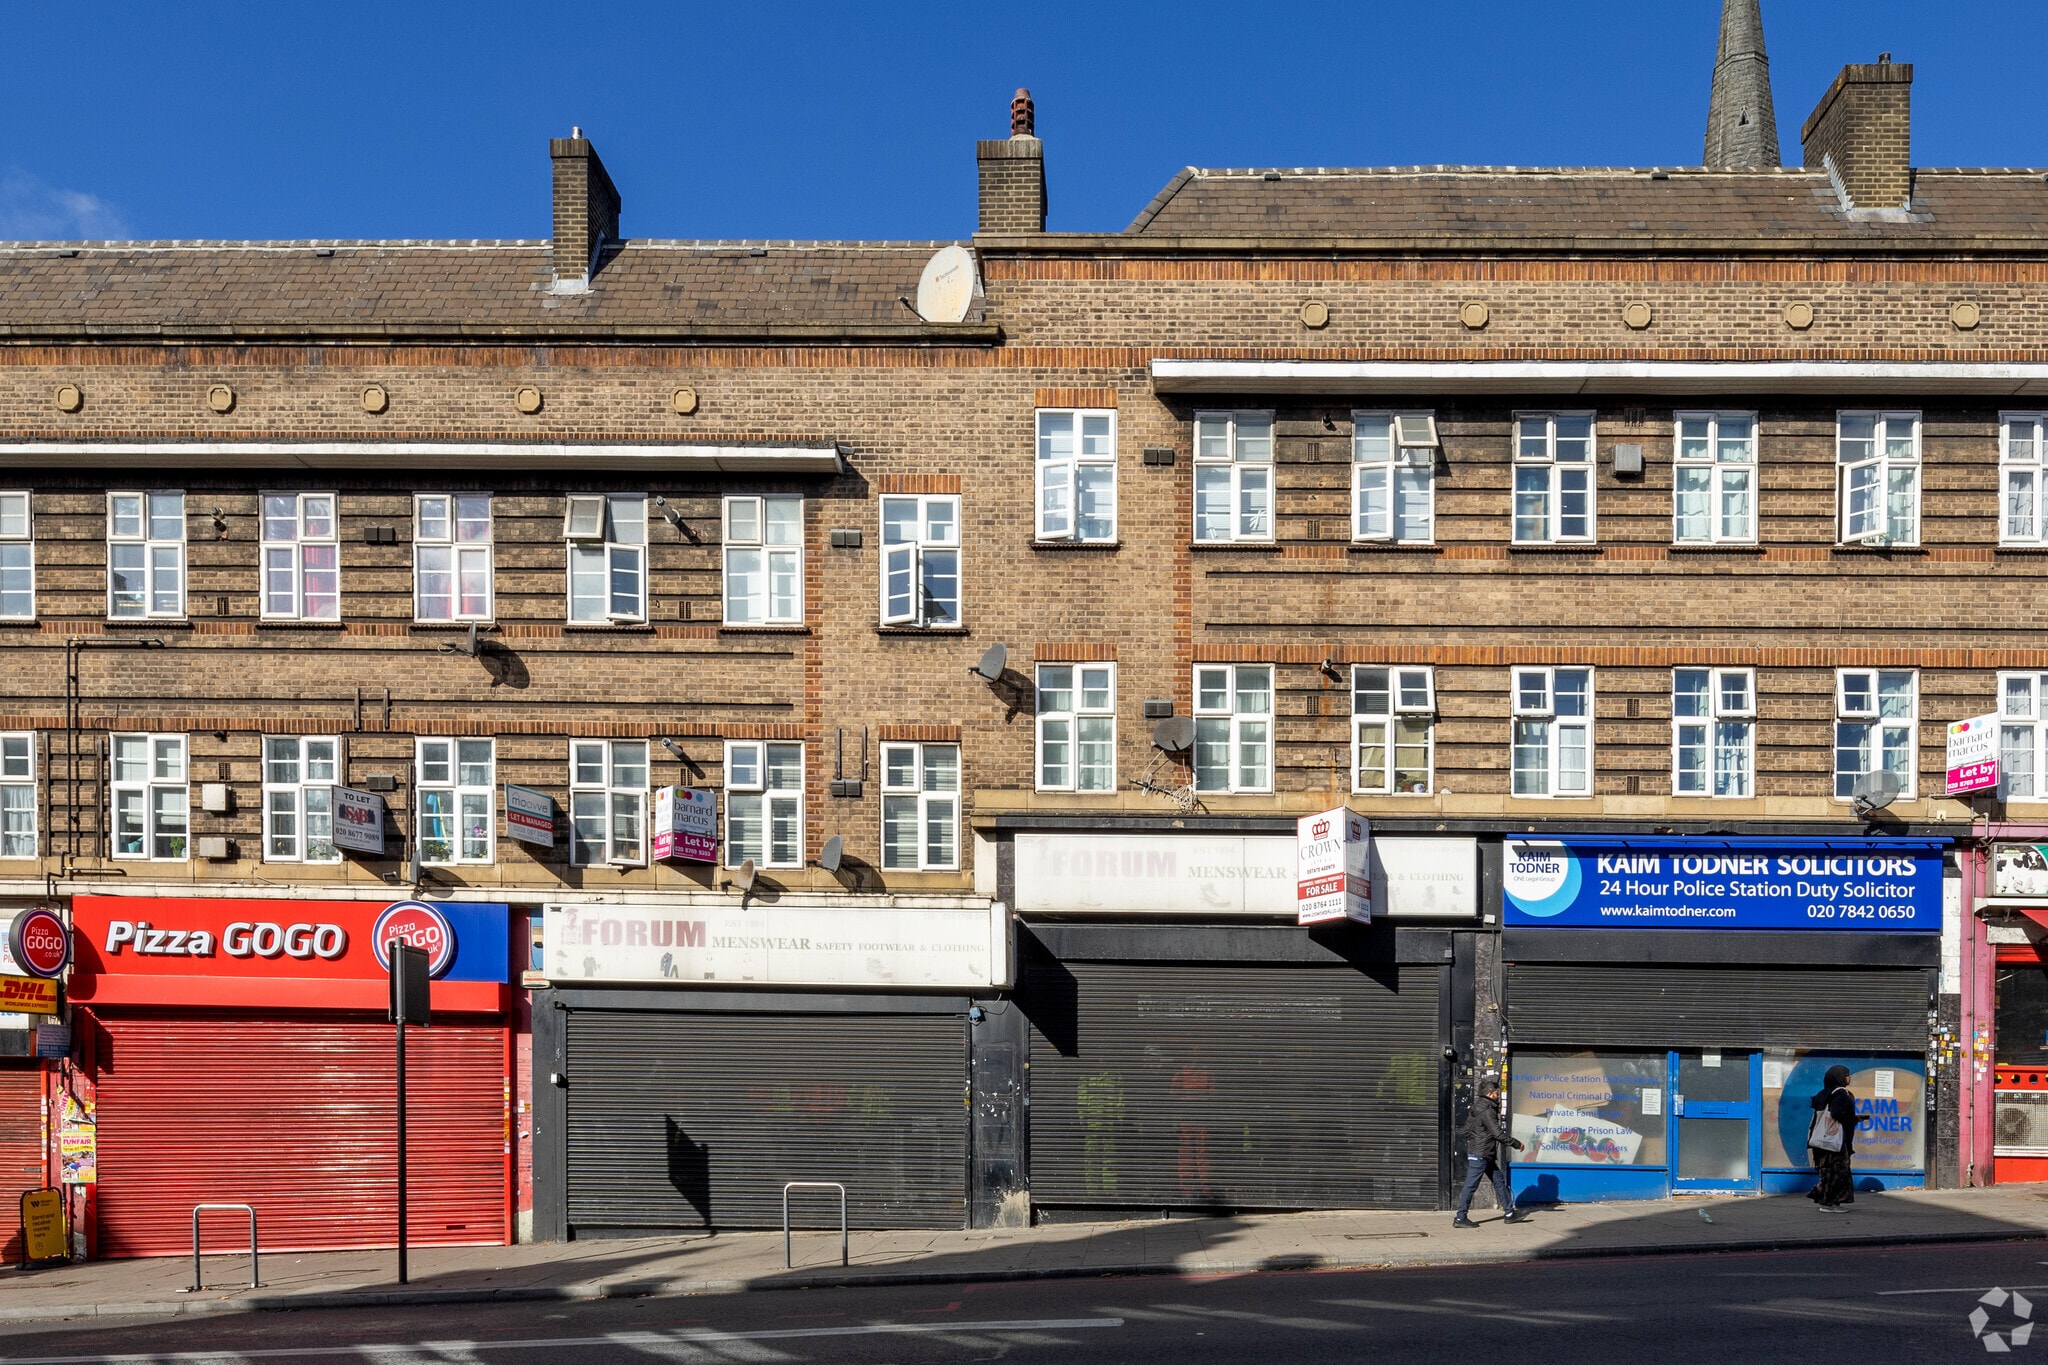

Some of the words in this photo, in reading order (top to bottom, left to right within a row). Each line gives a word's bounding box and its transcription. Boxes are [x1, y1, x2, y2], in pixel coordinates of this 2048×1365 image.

[1949, 727, 1993, 748] barnard
[1949, 743, 1988, 758] marcus
[1960, 767, 1978, 778] Let
[1980, 764, 1995, 775] by
[675, 799, 713, 817] barnard
[520, 815, 526, 823] &
[526, 817, 552, 829] MANAGED
[675, 812, 708, 826] marcus
[335, 827, 347, 836] 020
[348, 830, 363, 839] 8677
[685, 836, 701, 846] Let
[703, 839, 715, 851] by
[1300, 837, 1341, 860] CROWN
[1052, 851, 1177, 877] FORUM
[1518, 852, 1550, 862] KAIM
[1307, 866, 1320, 874] ESTATE
[1509, 863, 1560, 874] TODNER
[1597, 854, 1661, 874] KAIM
[1669, 854, 1768, 875] TODNER
[1777, 855, 1917, 876] SOLICITORS
[1188, 866, 1286, 879] MENSWEAR
[1399, 873, 1405, 881] &
[1410, 872, 1464, 881] CLOTHING
[1306, 885, 1320, 896] FOR
[1321, 882, 1338, 894] SALE
[1600, 881, 1621, 895] 24
[1626, 881, 1669, 896] Hour
[1674, 880, 1725, 896] Police
[1729, 881, 1791, 897] Station
[1797, 882, 1839, 901] Duty
[1843, 882, 1915, 898] Solicitor
[1302, 903, 1312, 911] 020
[1313, 900, 1327, 910] 8764
[1329, 898, 1341, 907] 1111
[1600, 904, 1736, 918] www.kaimtodner.com
[1807, 905, 1835, 918] 020
[1839, 905, 1874, 918] 7842
[1878, 905, 1915, 919] 0650
[31, 926, 48, 936] Pizza
[388, 922, 416, 936] Pizza
[582, 919, 706, 948] FORUM
[27, 936, 63, 949] GOGO
[105, 920, 214, 954] Pizza
[222, 921, 346, 958] GOGO
[712, 936, 811, 949] MENSWEAR
[816, 942, 853, 951] SAFETY
[858, 943, 915, 952] FOOTWEAR
[920, 944, 926, 952] &
[932, 943, 985, 953] CLOTHING
[3, 980, 56, 1002] DHL
[1571, 1075, 1600, 1083] Station
[1603, 1076, 1623, 1084] Duty
[1529, 1091, 1564, 1099] National
[1567, 1092, 1603, 1100] Criminal
[1854, 1098, 1898, 1114] KAIM
[1545, 1109, 1574, 1117] Private
[1576, 1109, 1603, 1119] Family
[1606, 1110, 1622, 1118] Law
[1536, 1125, 1581, 1134] Extradition
[1588, 1127, 1613, 1135] Prison
[1616, 1127, 1633, 1135] Law
[1854, 1116, 1912, 1132] DNER
[1858, 1137, 1878, 1145] Legal
[1880, 1137, 1904, 1145] Group
